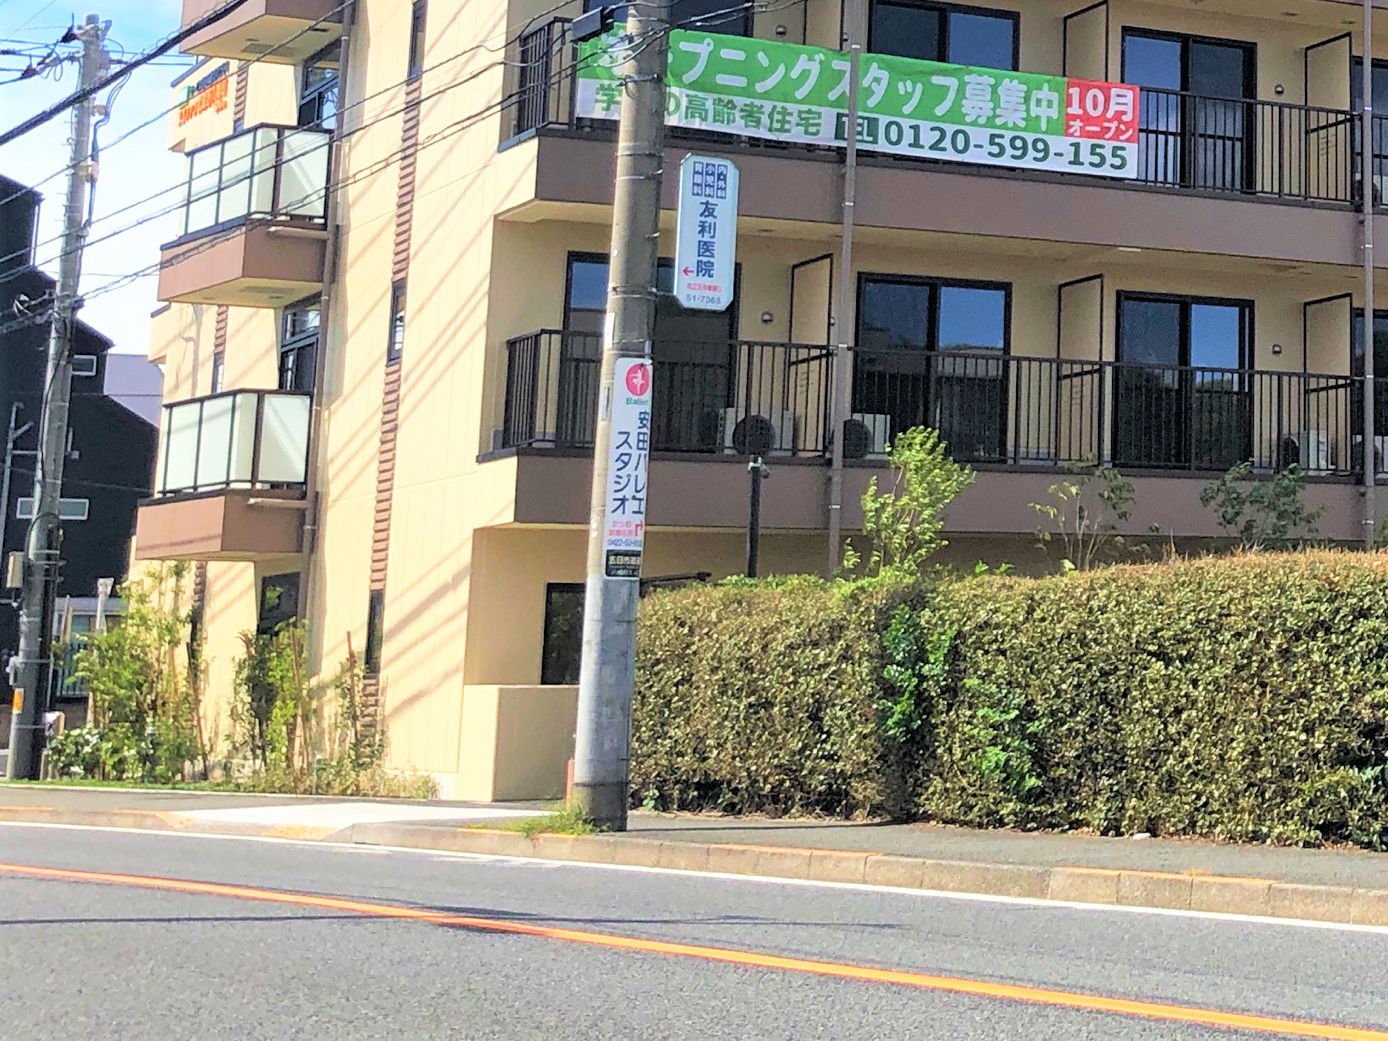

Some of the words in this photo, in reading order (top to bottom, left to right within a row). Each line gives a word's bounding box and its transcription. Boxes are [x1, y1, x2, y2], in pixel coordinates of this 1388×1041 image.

[594, 82, 822, 136] 学の高齢者住宅
[1066, 86, 1134, 122] 10月
[1067, 119, 1134, 141] オープン
[884, 120, 1128, 171] 0120-599-155
[696, 200, 718, 278] 友利医院
[611, 430, 633, 515] スタジオ
